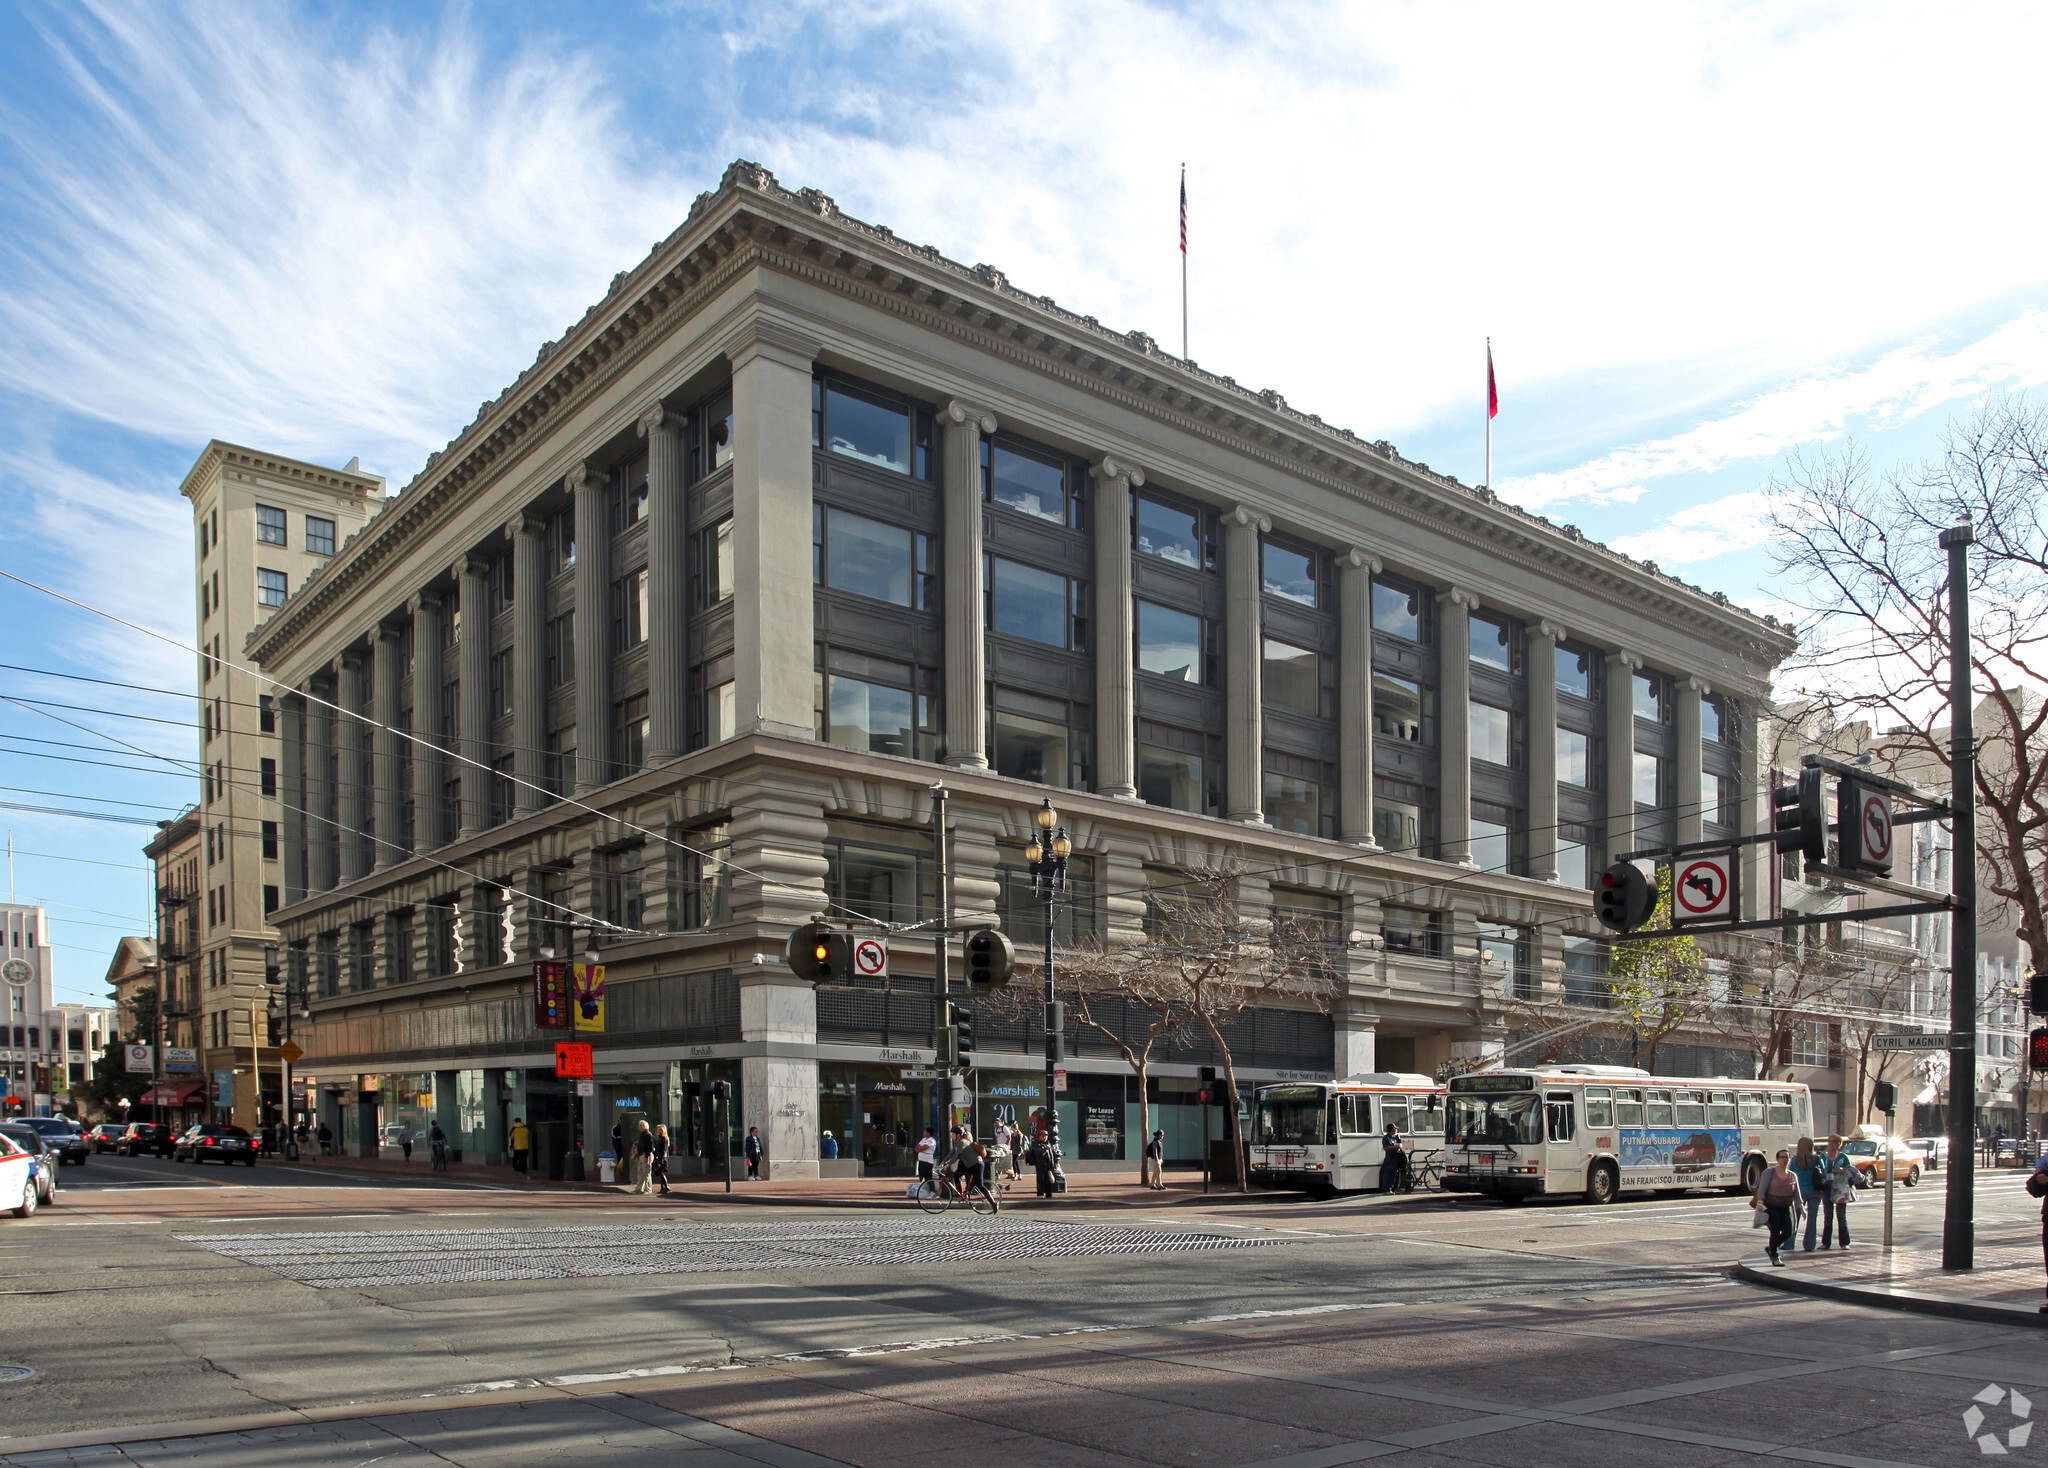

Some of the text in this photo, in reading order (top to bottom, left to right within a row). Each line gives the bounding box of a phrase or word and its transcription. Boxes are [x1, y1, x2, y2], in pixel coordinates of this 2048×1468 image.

[1876, 1038, 1944, 1047] CYRIL MAGNIN
[690, 1046, 713, 1056] Marshalls
[879, 1049, 922, 1060] Marshalls
[874, 1082, 906, 1091] Marshalls
[991, 1085, 1040, 1096] Marshalls
[616, 1097, 641, 1107] Marshalls
[1622, 1136, 1680, 1145] PUTNAM SUBARU
[1622, 1177, 1634, 1186] SAN
[1636, 1176, 1672, 1185] FRANCISCO
[1677, 1174, 1716, 1183] BURLINGAME
